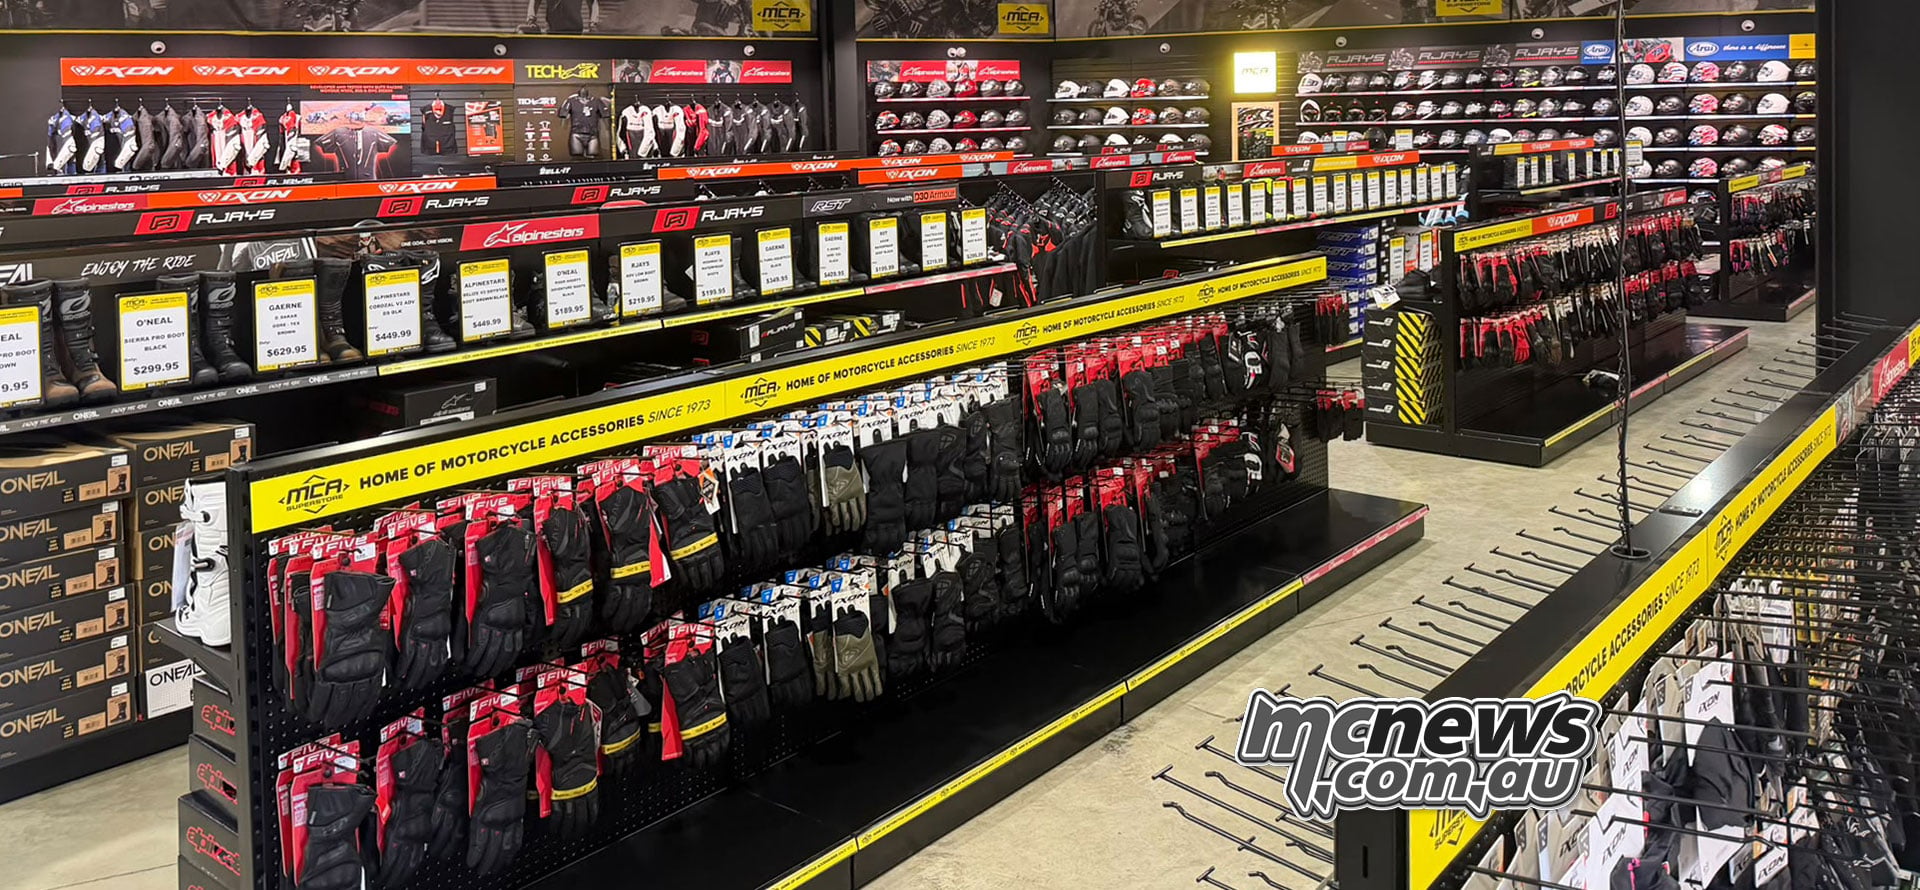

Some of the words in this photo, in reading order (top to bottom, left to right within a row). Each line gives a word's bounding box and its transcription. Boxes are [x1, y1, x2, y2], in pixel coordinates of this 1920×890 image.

[763, 8, 800, 18] MCA
[1007, 11, 1040, 21] MCA
[1419, 50, 1481, 61] RJAYS
[1515, 46, 1580, 57] RJAYS
[1326, 53, 1387, 64] RJAYS
[1152, 171, 1184, 181] RJAYS
[609, 186, 662, 197] RJAYS
[930, 190, 957, 200] Armour
[74, 201, 136, 212] alpinestars
[425, 196, 490, 209] RJAYS
[811, 198, 851, 213] RST
[195, 209, 276, 225] RJAYS
[700, 204, 765, 222] RJAYS
[512, 227, 584, 244] alpinestars
[81, 260, 129, 278] ENJOY
[132, 257, 161, 272] THE
[163, 254, 197, 268] RIDE
[631, 261, 650, 269] RJAYS
[464, 278, 506, 289] ALPINESTARS
[1217, 284, 1231, 294] HOME
[1232, 283, 1239, 291] OF
[1240, 276, 1270, 290] MOTORCYCLE
[1271, 270, 1300, 282] ACCESSORIES
[373, 292, 411, 301] ALPINESTARS
[701, 287, 726, 297] $199.95
[268, 302, 303, 312] GAERNE
[628, 295, 656, 306] $219.95
[554, 305, 584, 316] $189.95
[136, 316, 173, 327] O'NEAL
[473, 318, 502, 329] $449.99
[1043, 322, 1062, 334] HOME
[1063, 320, 1073, 329] OF
[1074, 310, 1115, 327] MOTORCYCLE
[1117, 301, 1156, 318] ACCESSORIES
[124, 336, 150, 344] SIERRA
[151, 334, 166, 342] PRO
[166, 332, 185, 340] BOOT
[375, 330, 412, 342] $449.99
[1016, 325, 1038, 338] MCA
[266, 345, 307, 358] $629.95
[133, 362, 180, 376] $299.95
[786, 376, 815, 391] HOME
[818, 373, 831, 383] OF
[833, 357, 895, 380] MOTORCYCLE
[897, 345, 955, 366] ACCESSORIES
[956, 340, 978, 354] SINCE
[980, 336, 996, 348] 1973
[744, 381, 777, 399] MCA
[819, 429, 851, 440] IXON
[359, 467, 409, 490] HOME
[414, 461, 436, 477] OF
[441, 436, 546, 471] MOTORCYCLE
[550, 414, 645, 446] ACCESSORIES
[647, 407, 683, 424] SINCE
[686, 399, 711, 415] 1973
[764, 439, 798, 451] IXON
[727, 450, 756, 463] IXON
[601, 458, 631, 479] FIVE
[540, 477, 566, 491] FIVE
[1734, 508, 1750, 533] HOME
[1750, 502, 1758, 515] OF
[1757, 469, 1787, 507] MOTORCYCLE
[1786, 443, 1813, 476] ACCESSORIES
[287, 478, 342, 506] MCA
[286, 494, 343, 512] SUPERSTORE
[474, 497, 509, 511] FIVE
[397, 515, 427, 531] FIVE
[325, 535, 368, 553] FIVE
[1608, 592, 1663, 658] ACCESSORIES
[1664, 570, 1685, 605] SINCE
[1685, 557, 1701, 587] 1973
[677, 623, 704, 636] FIVE
[1698, 690, 1721, 715] IXON
[1757, 855, 1786, 882] IXON
